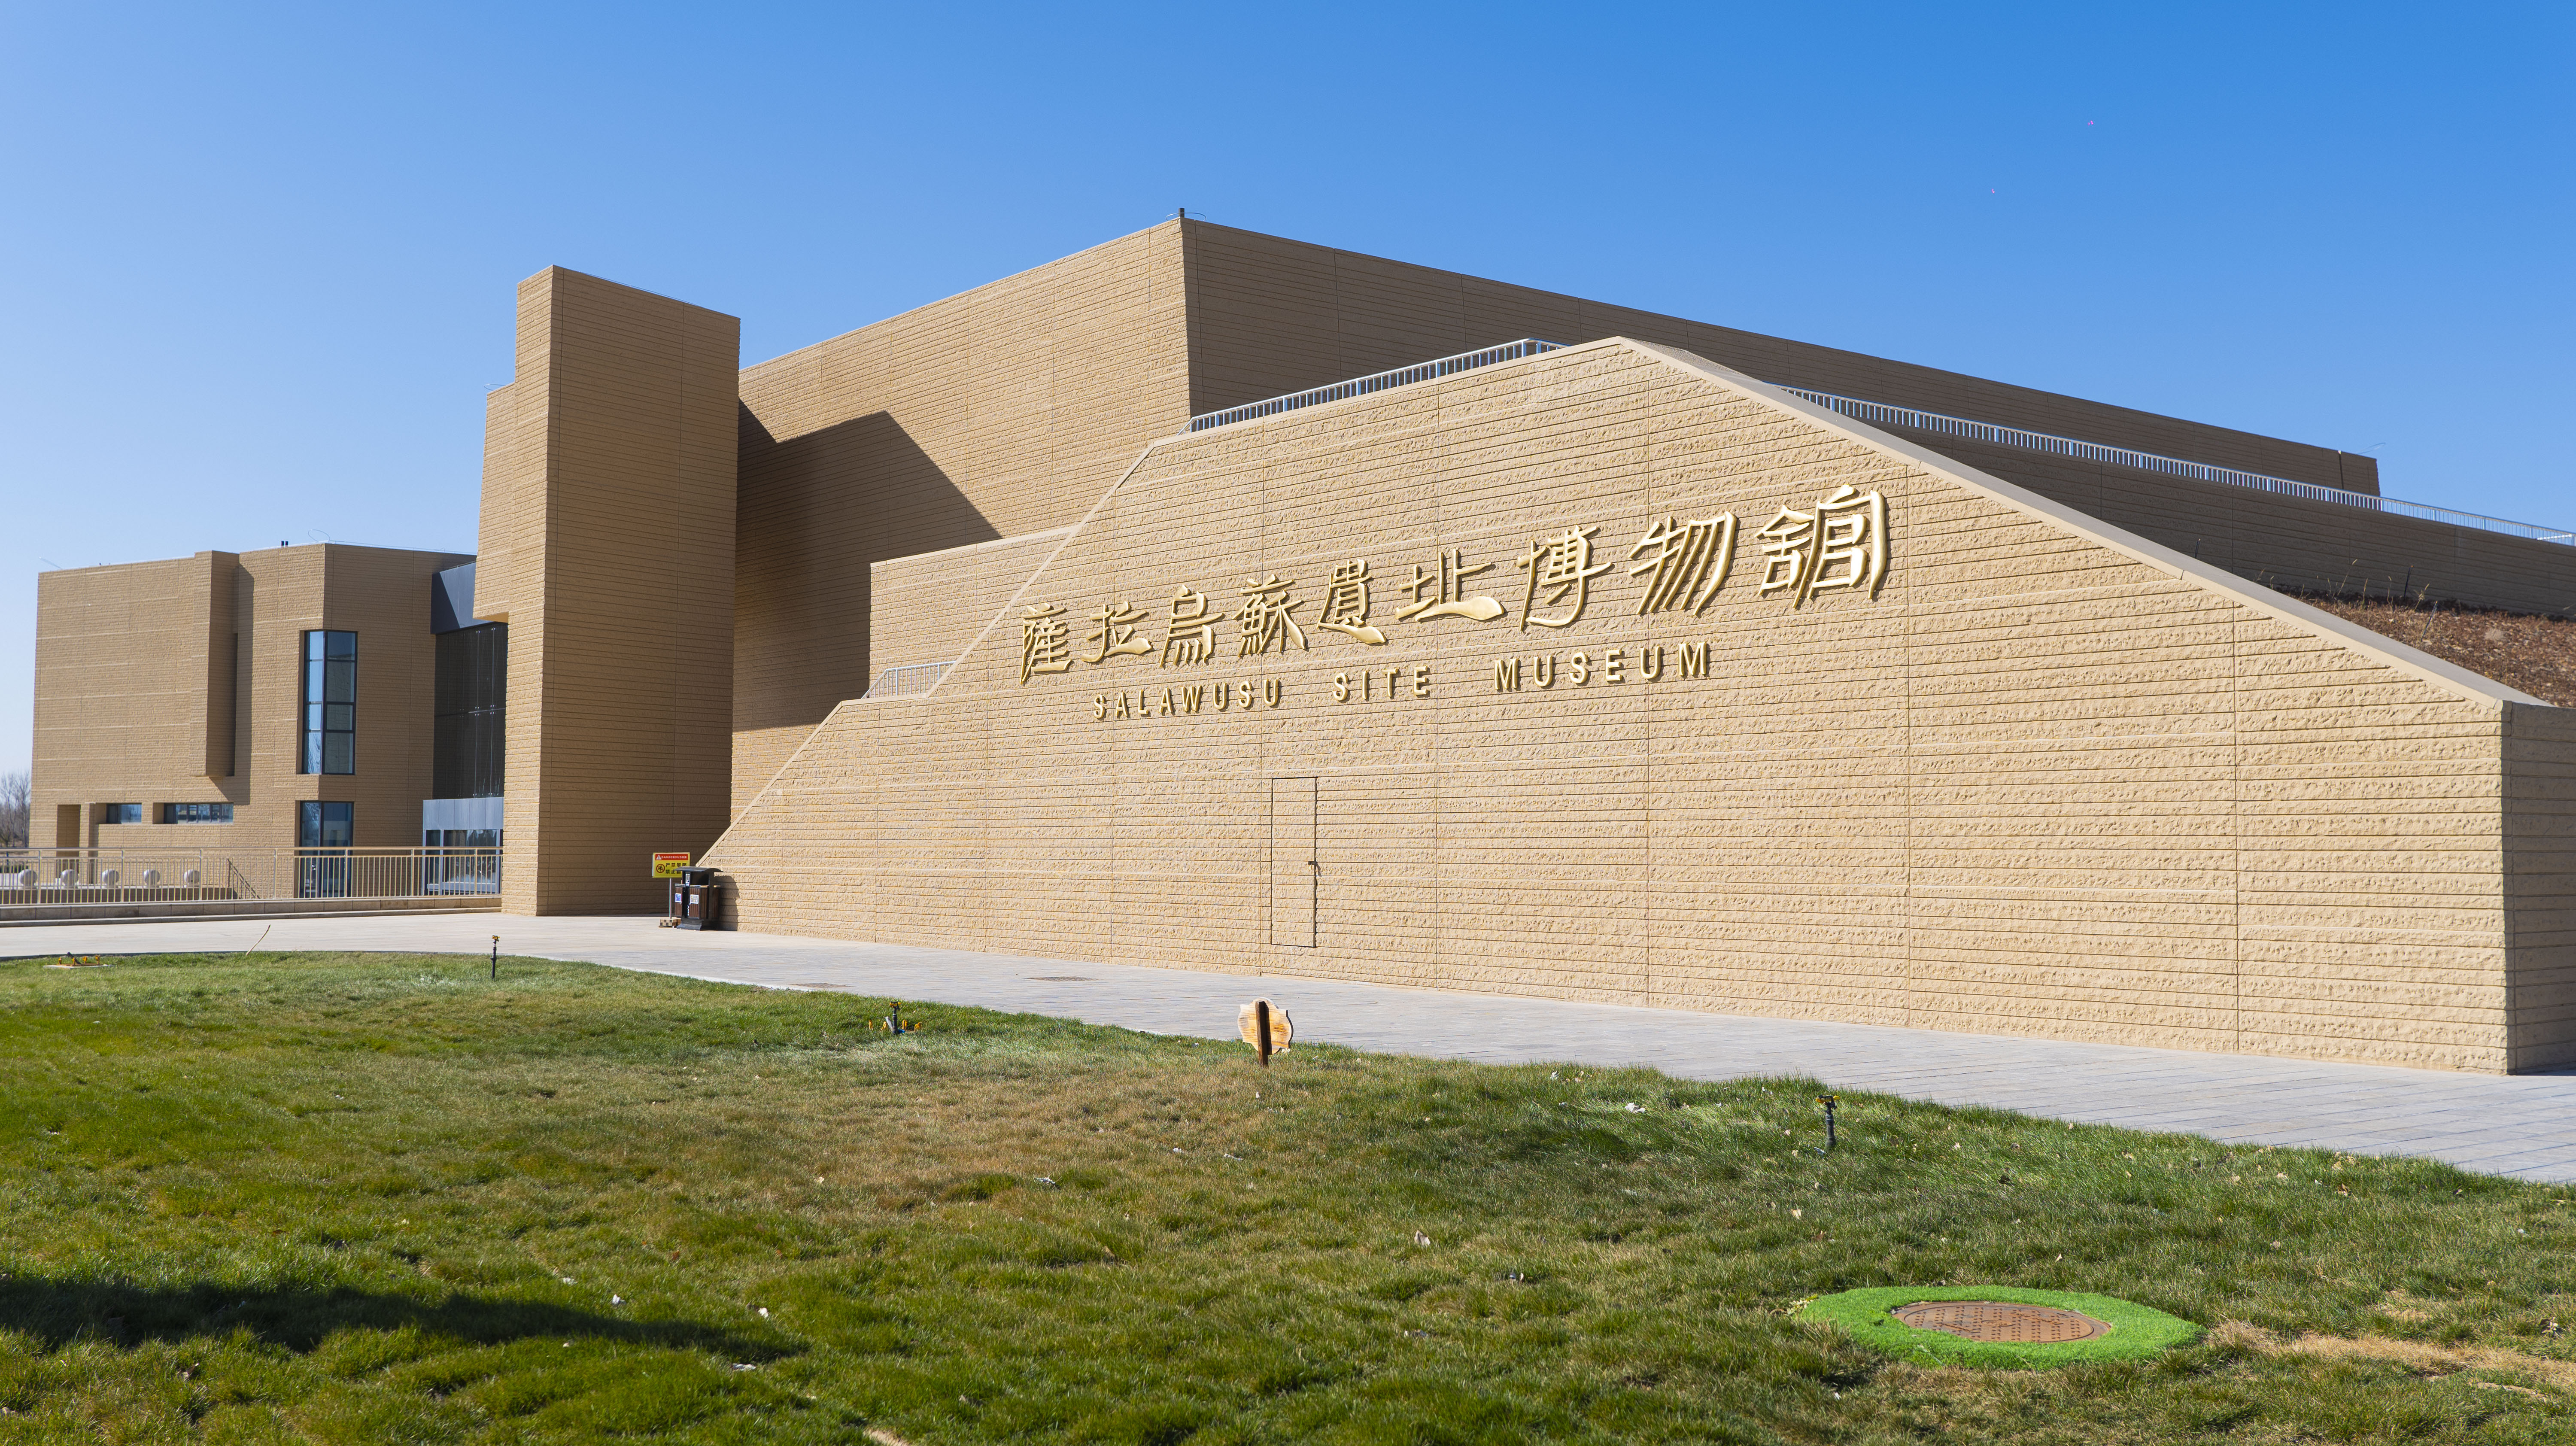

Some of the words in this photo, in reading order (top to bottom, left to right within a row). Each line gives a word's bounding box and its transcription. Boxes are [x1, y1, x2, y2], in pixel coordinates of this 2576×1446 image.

[1093, 679, 1279, 719] SALAWUSU
[1333, 665, 1428, 702] SITE
[1494, 641, 1708, 690] MUSEUM
